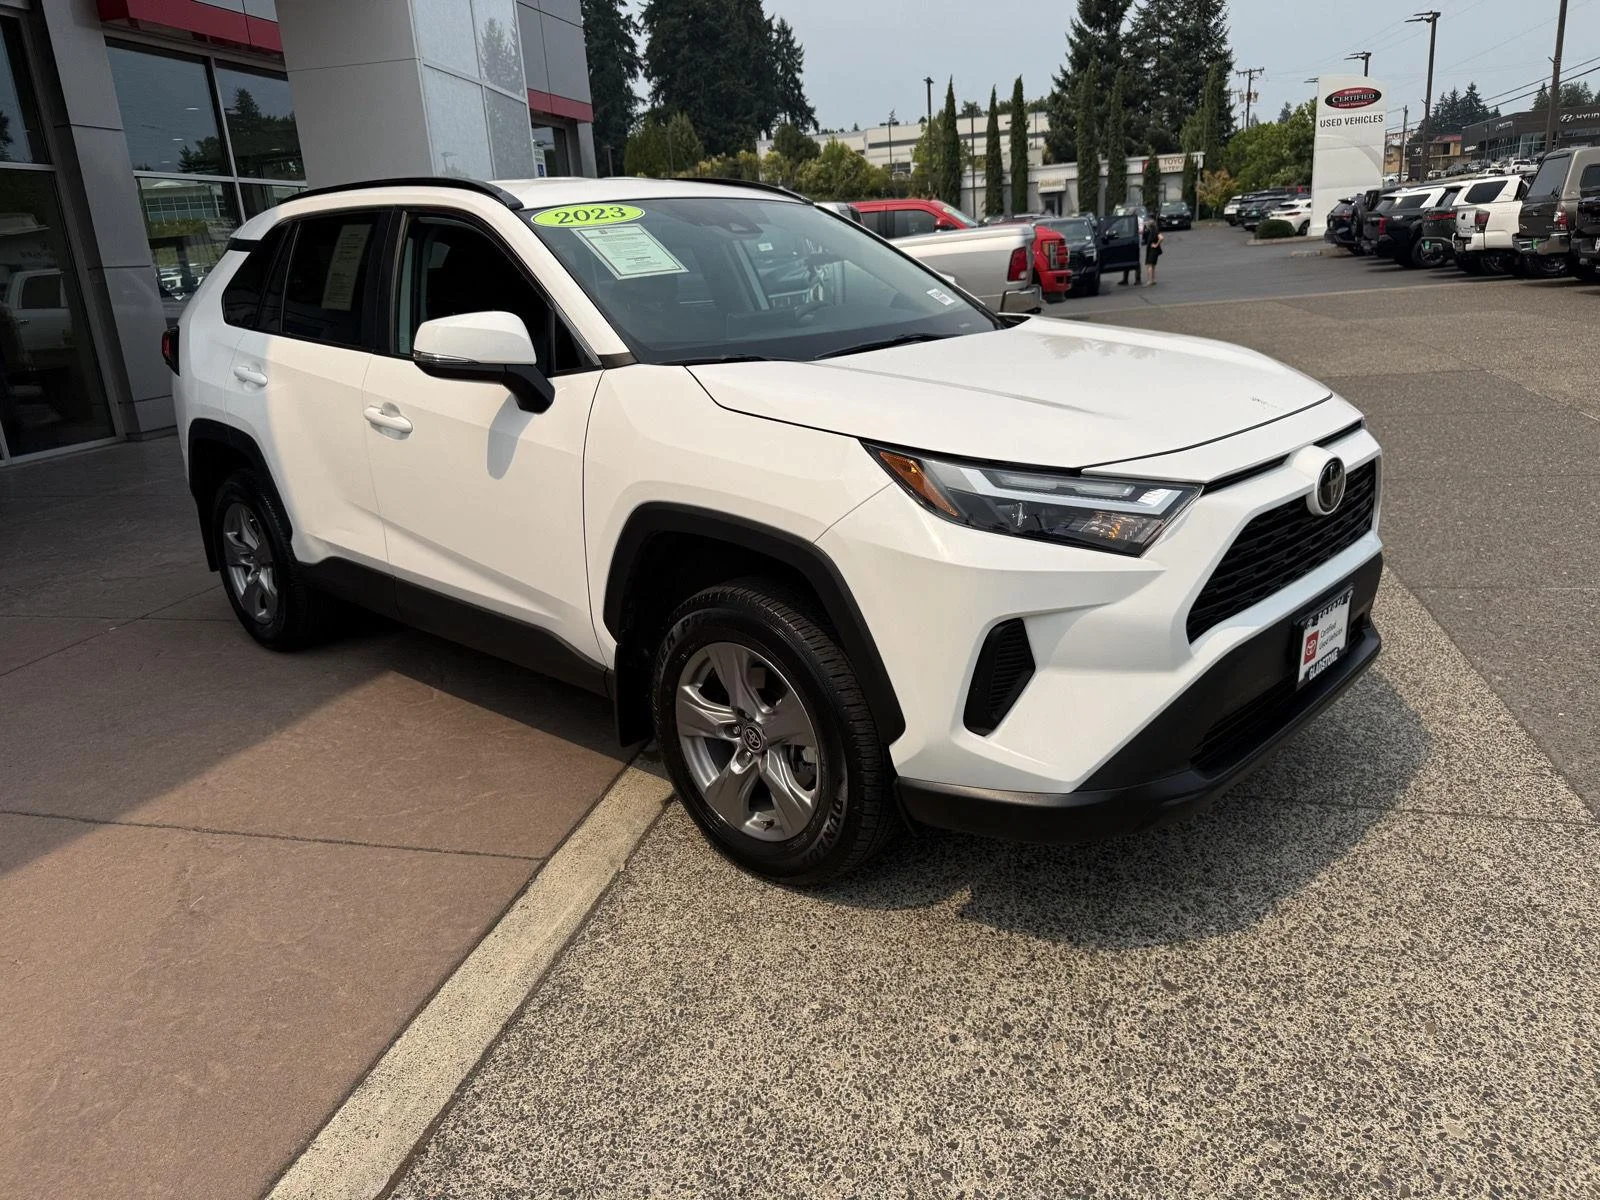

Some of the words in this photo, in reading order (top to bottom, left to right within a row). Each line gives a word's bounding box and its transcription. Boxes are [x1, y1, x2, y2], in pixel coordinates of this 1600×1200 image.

[1332, 93, 1375, 103] CERTIFIED
[1320, 118, 1342, 128] USED
[1344, 114, 1384, 126] VEHICLES
[554, 206, 627, 225] 2023
[1309, 649, 1338, 680] GLADSTONE
